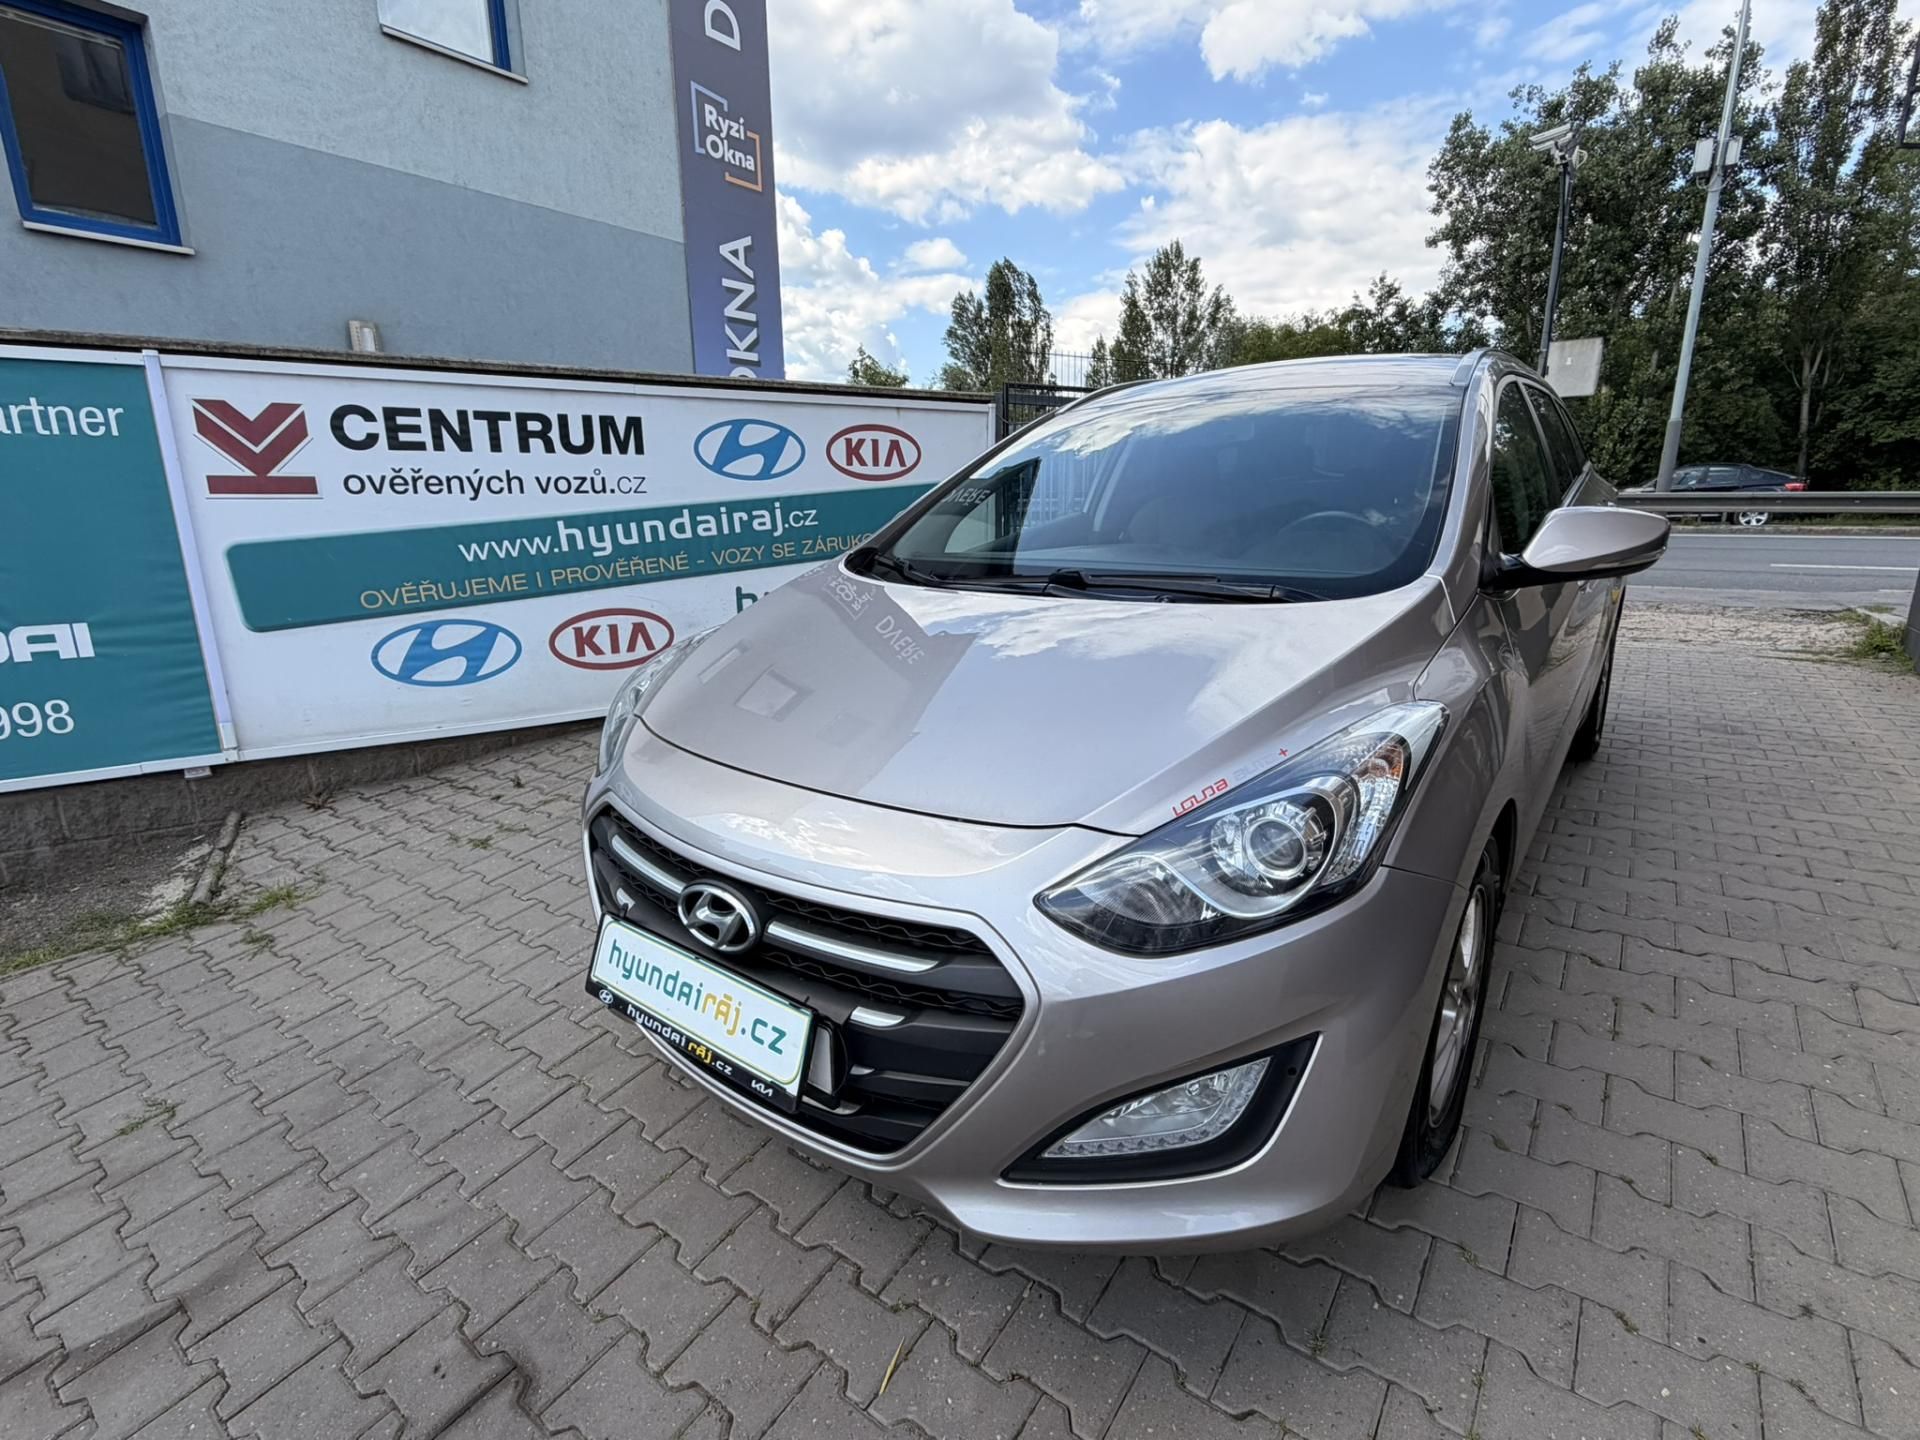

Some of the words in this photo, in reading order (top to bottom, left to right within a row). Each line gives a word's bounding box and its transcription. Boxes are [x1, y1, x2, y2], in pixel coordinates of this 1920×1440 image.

[705, 134, 755, 172] Okna
[330, 404, 645, 455] CENTRUM
[844, 437, 907, 468] KIA
[343, 467, 525, 501] ověřených
[534, 468, 648, 495] vozů.cz
[458, 502, 819, 562] www.hyundairaj.cz
[360, 572, 529, 609] OVĚŘUJEME
[536, 571, 543, 588] I
[551, 551, 690, 586] PROVĚŘENÉ
[712, 545, 765, 566] VOZY
[771, 542, 797, 559] SE
[0, 622, 95, 664] AI
[572, 622, 656, 657] KIA
